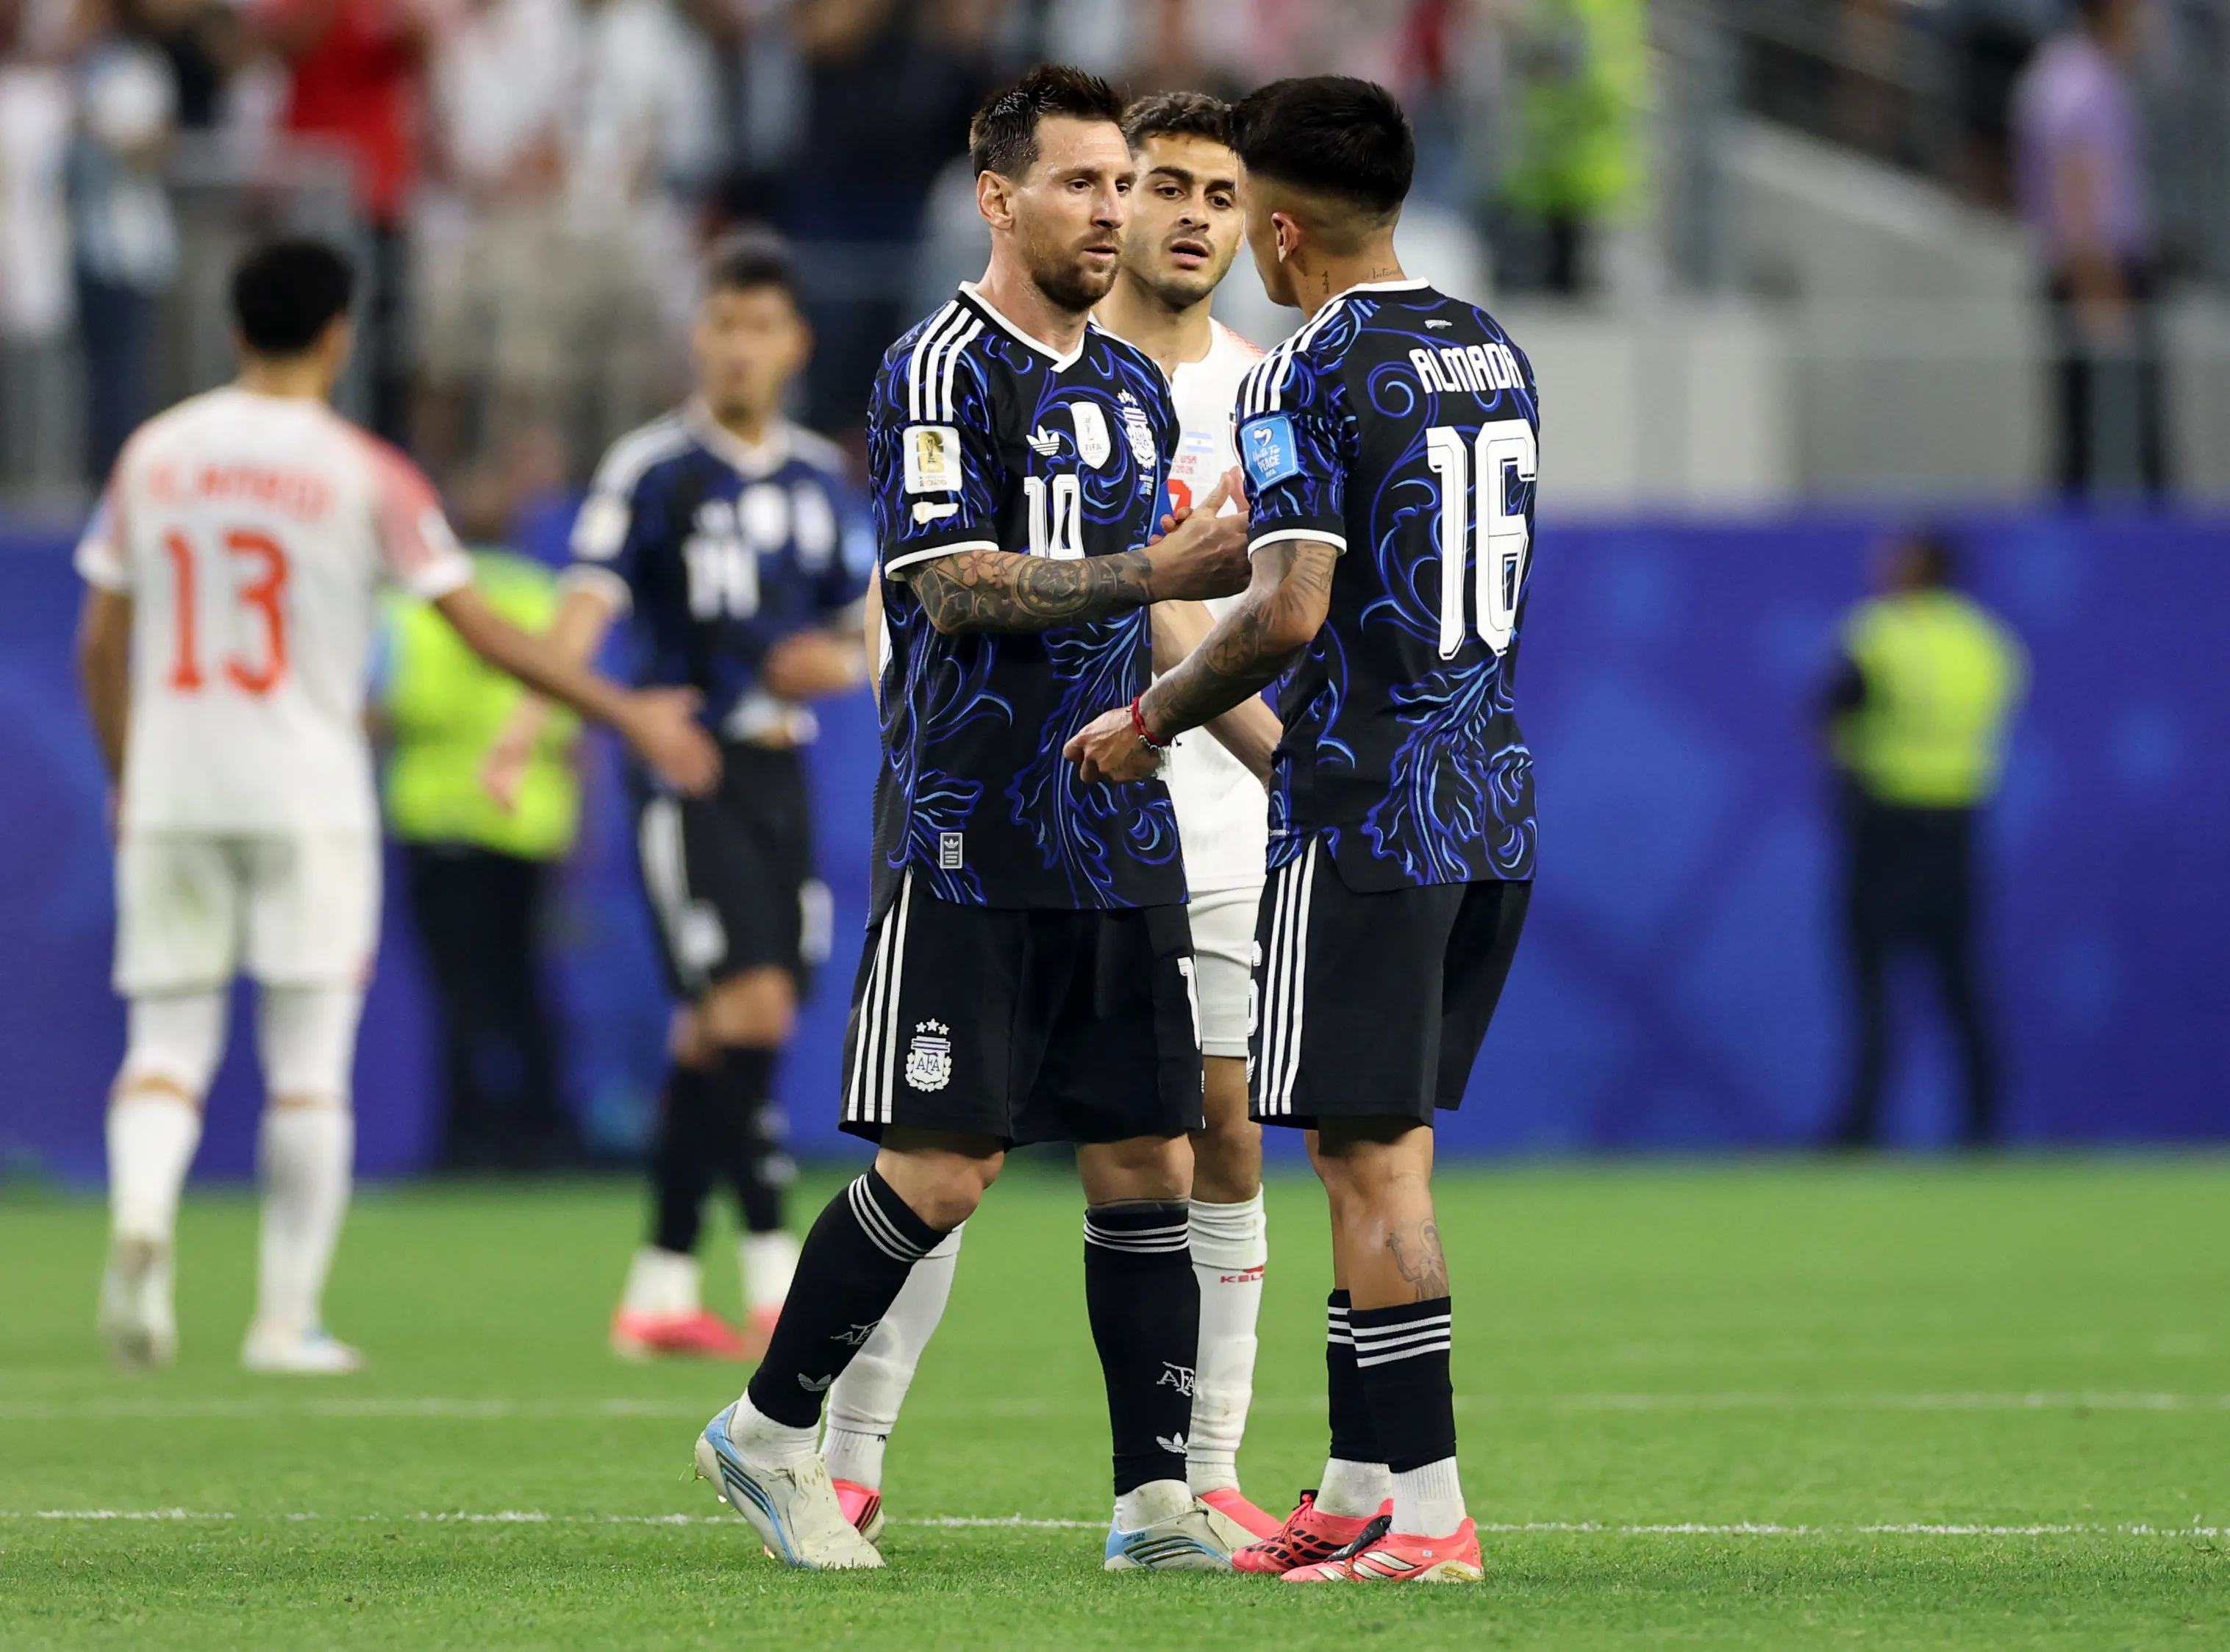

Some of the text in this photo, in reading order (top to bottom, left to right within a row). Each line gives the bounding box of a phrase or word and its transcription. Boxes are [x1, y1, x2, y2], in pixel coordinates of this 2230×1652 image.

[1409, 343, 1525, 394] ALMADA
[1085, 443, 1103, 451] FIFA
[1257, 455, 1281, 473] PEACE
[1024, 474, 1086, 560] 10
[1426, 418, 1537, 660] 16
[163, 530, 288, 694] 13
[1177, 955, 1203, 1050] 1
[916, 1052, 940, 1076] AFA
[1156, 1361, 1195, 1397] AFA
